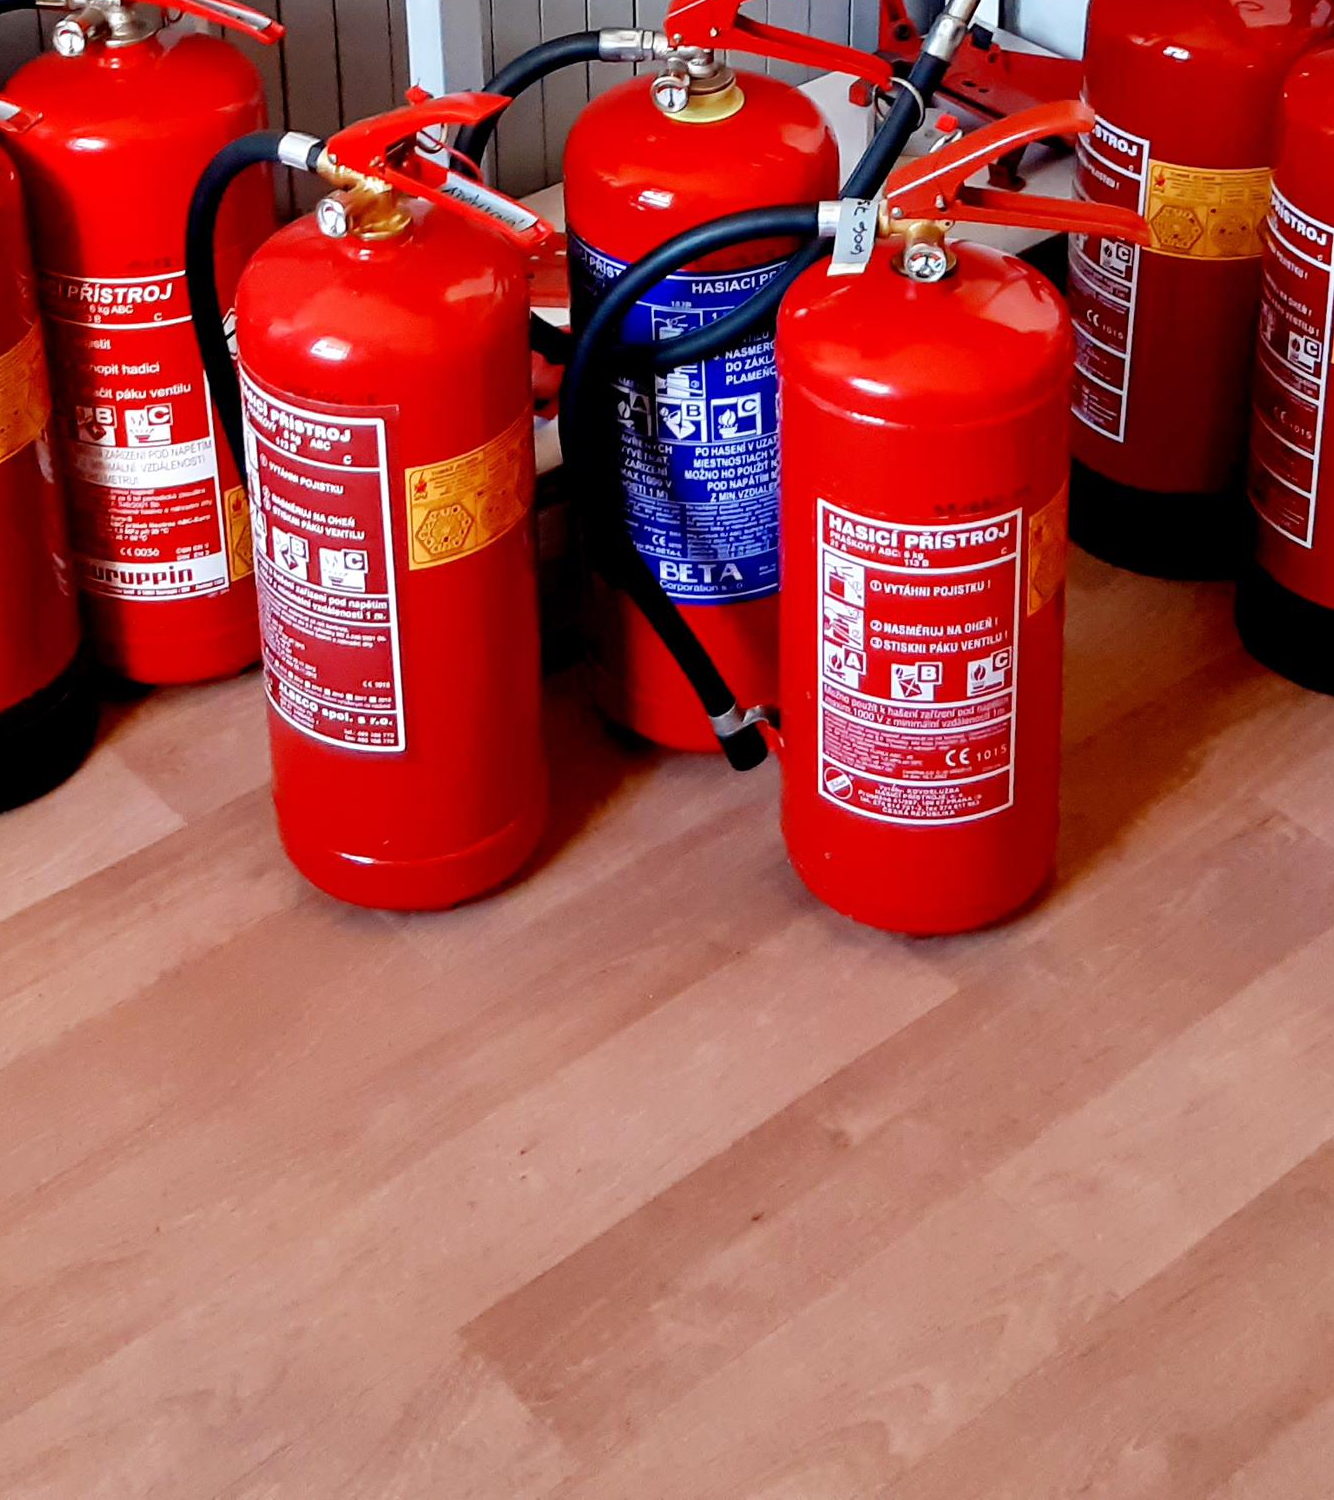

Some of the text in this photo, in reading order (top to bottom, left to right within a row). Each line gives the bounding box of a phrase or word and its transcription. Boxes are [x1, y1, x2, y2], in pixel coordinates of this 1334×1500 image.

[1095, 124, 1137, 156] STROJ
[1118, 248, 1129, 260] C
[68, 283, 172, 304] PŘÍSTROJ
[111, 305, 133, 314] ABC
[154, 313, 162, 321] C
[1309, 341, 1319, 355] C
[122, 362, 160, 374] hadici
[726, 363, 741, 372] DO
[116, 384, 191, 401] páku ventilu
[687, 405, 700, 417] B
[742, 399, 756, 412] C
[96, 408, 113, 424] B
[149, 406, 170, 424] C
[270, 409, 351, 442] PŘÍSTROJ
[310, 439, 331, 451] ABC
[343, 455, 352, 464] C
[696, 448, 709, 457] PO
[694, 454, 767, 468] MIESTNOSTIACH
[685, 469, 734, 479] MOŽNO HO
[300, 475, 344, 495] POJISTKU
[708, 482, 727, 491] POD
[313, 511, 326, 523] NA
[329, 516, 355, 527] OHEŇ
[302, 519, 323, 533] PÁKU
[325, 525, 365, 539] VENTILU
[829, 514, 1009, 550] HASICÍ PŘÍSTROJ
[293, 539, 304, 556] B
[345, 552, 363, 569] C
[92, 566, 193, 585] uruppin
[660, 561, 743, 583] BETA
[660, 580, 717, 592] Corporation
[883, 582, 984, 596] VYTÁHNI POJISTKU
[329, 597, 346, 608] pod
[883, 617, 992, 637] NASMĚRUJ NA OHEŇ
[883, 634, 1002, 653] STISKNI PÁKU VENTILU
[847, 653, 861, 668] A
[995, 653, 1008, 667] C
[921, 667, 936, 680] B
[279, 682, 318, 712] ALBECO
[322, 708, 353, 722] spol.
[370, 717, 392, 725] r.o.
[853, 707, 875, 721] 1000
[977, 744, 1007, 761] 1015
